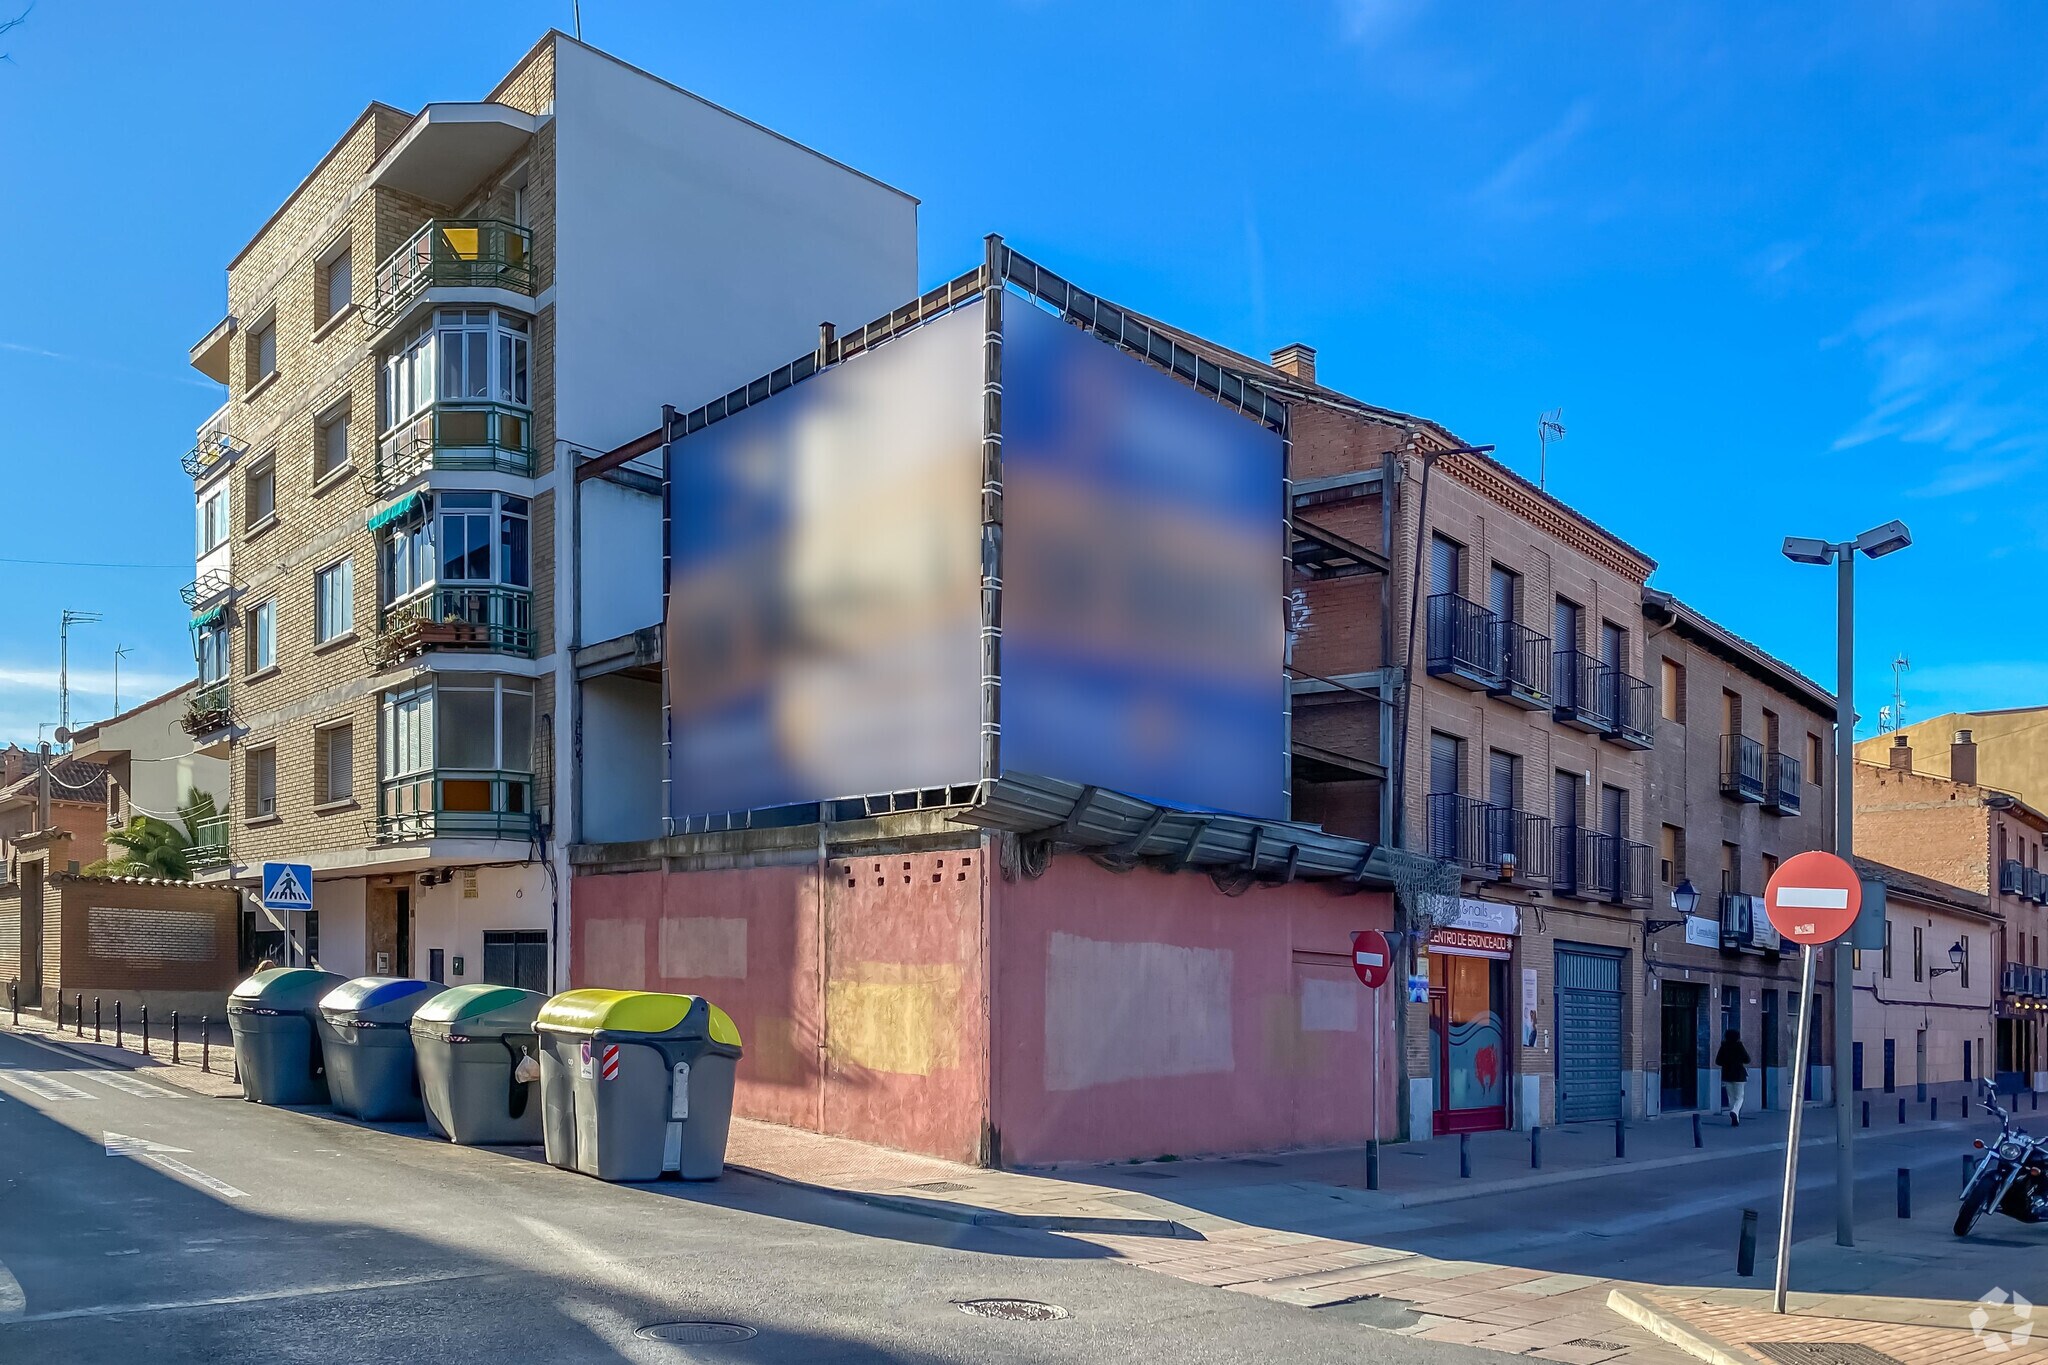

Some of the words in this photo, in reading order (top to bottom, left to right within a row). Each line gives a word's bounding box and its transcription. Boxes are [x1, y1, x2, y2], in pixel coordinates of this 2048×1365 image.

[1430, 929, 1456, 945] CENTRO
[1457, 931, 1467, 946] DE
[1468, 934, 1507, 950] BRONCEADO
